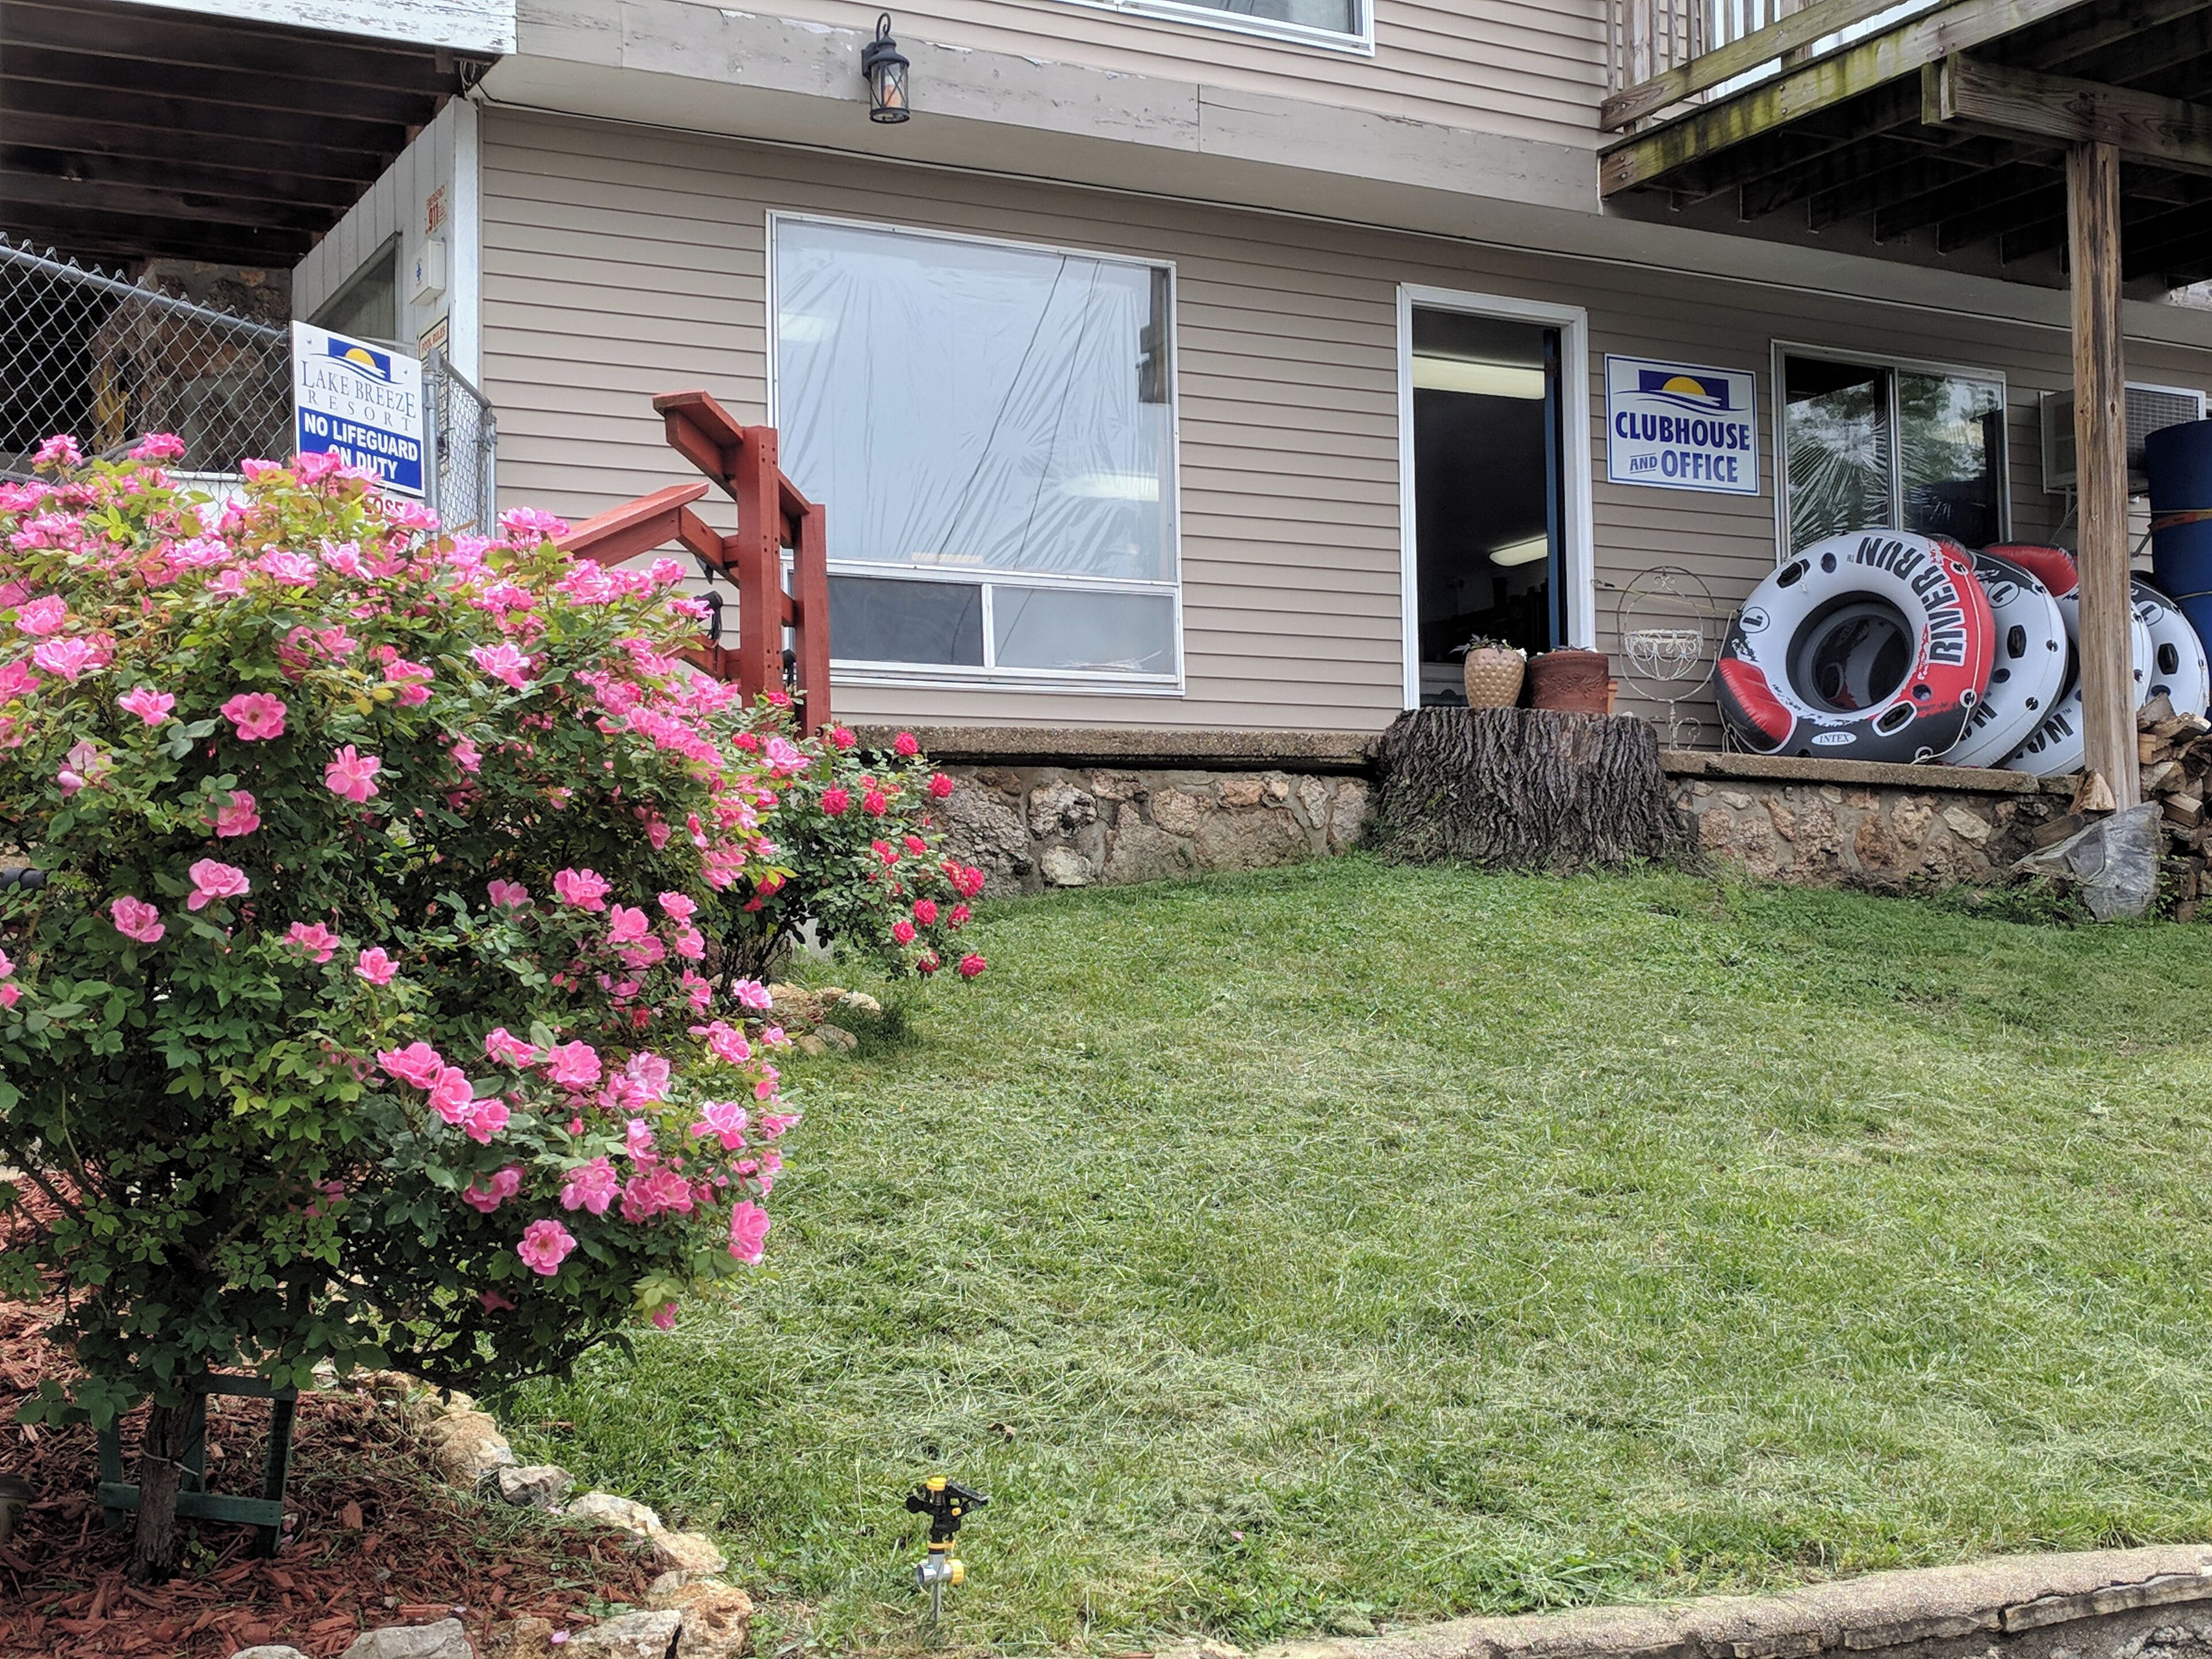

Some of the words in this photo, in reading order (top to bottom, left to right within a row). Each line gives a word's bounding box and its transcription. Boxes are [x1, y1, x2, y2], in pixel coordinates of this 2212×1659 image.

[429, 201, 439, 231] 911
[433, 325, 446, 344] RULES
[301, 360, 350, 396] LAKE
[355, 380, 416, 418] BREEZE
[308, 389, 411, 431] RESORT
[304, 412, 328, 437] NO
[332, 421, 418, 461] LIFEGUARD
[1615, 411, 1750, 450] CLUBHOUSE
[356, 451, 399, 479] DUTY
[1630, 455, 1658, 471] AND
[1661, 450, 1738, 483] OFFICE
[1856, 537, 1925, 581] RUN
[1911, 565, 1963, 663] RIVER
[1819, 733, 1850, 744] INTEX
